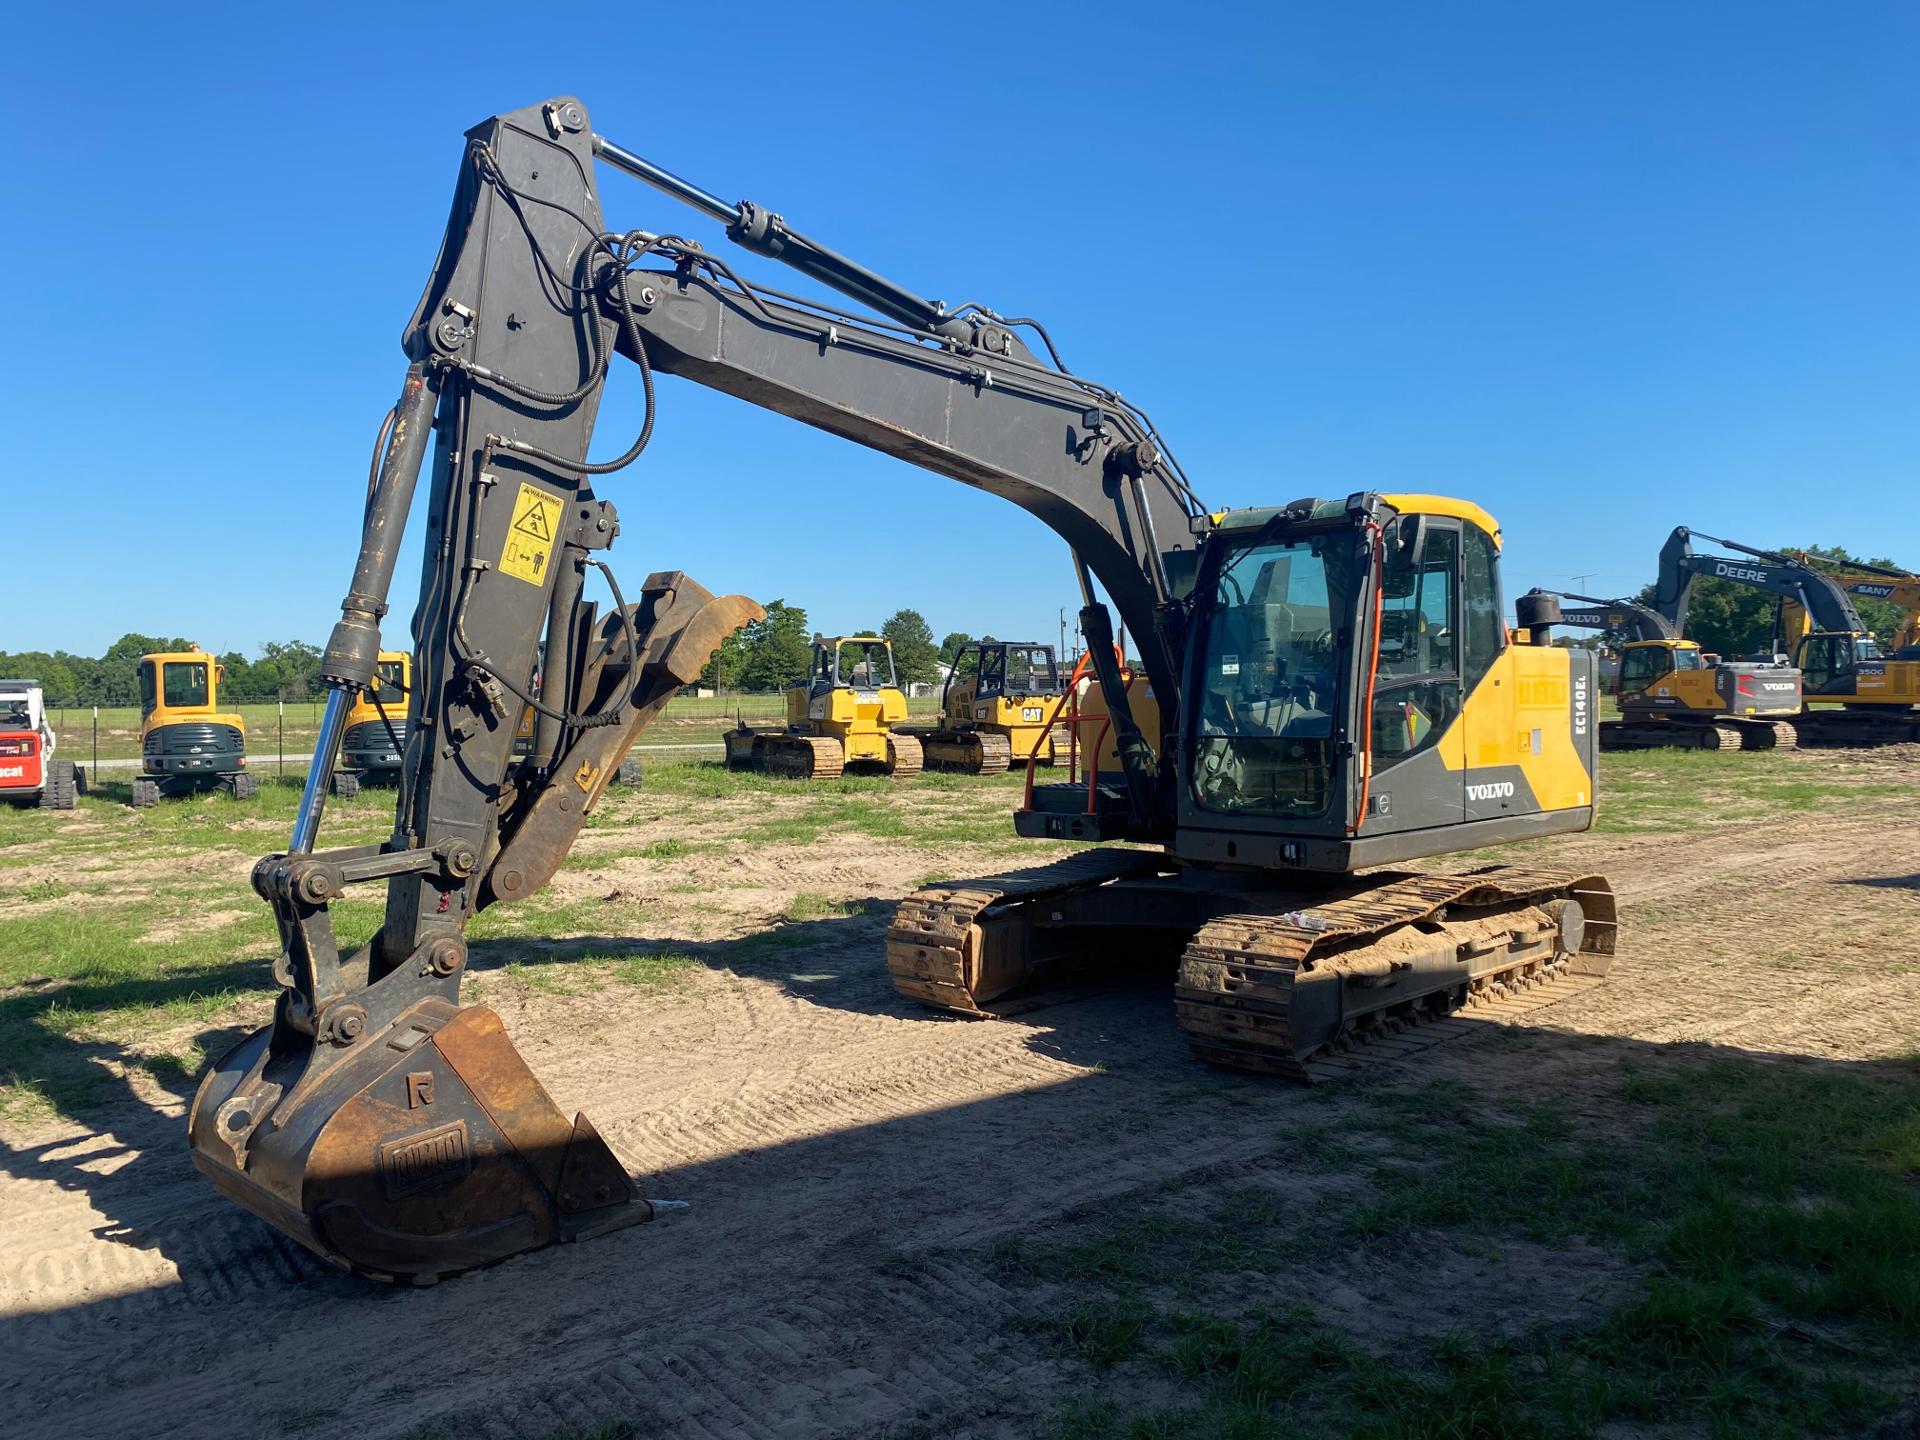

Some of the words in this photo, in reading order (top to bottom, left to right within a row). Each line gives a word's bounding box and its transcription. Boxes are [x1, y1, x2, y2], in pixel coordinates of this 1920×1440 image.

[530, 490, 562, 507] WARNING
[1715, 563, 1768, 583] DEERE
[1858, 585, 1890, 596] SANY
[1561, 614, 1601, 624] VOLVO
[1575, 675, 1586, 735] EC140EL
[977, 710, 986, 718] CAT
[1023, 709, 1041, 721] CAT
[1465, 782, 1514, 801] VOLVO
[406, 1071, 434, 1109] R
